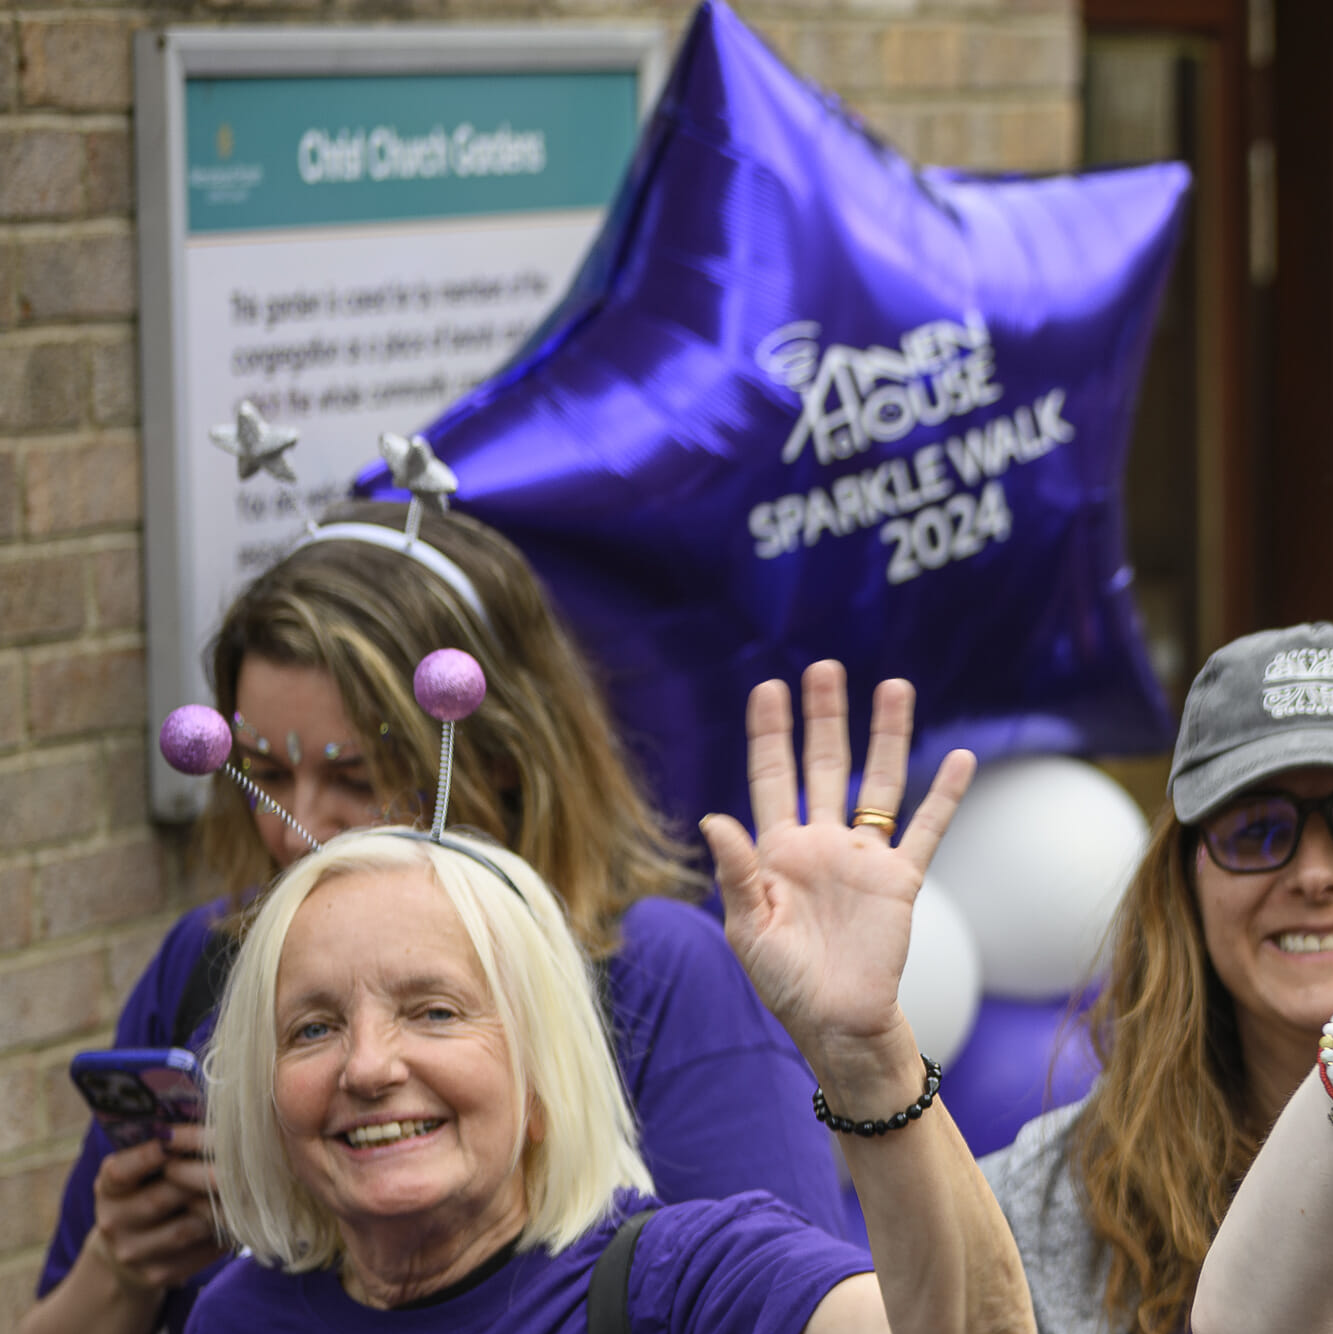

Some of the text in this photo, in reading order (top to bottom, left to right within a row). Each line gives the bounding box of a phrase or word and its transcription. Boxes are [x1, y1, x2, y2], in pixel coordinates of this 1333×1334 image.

[748, 387, 1075, 559] SPARKLE WALK
[880, 480, 1012, 584] 2024
